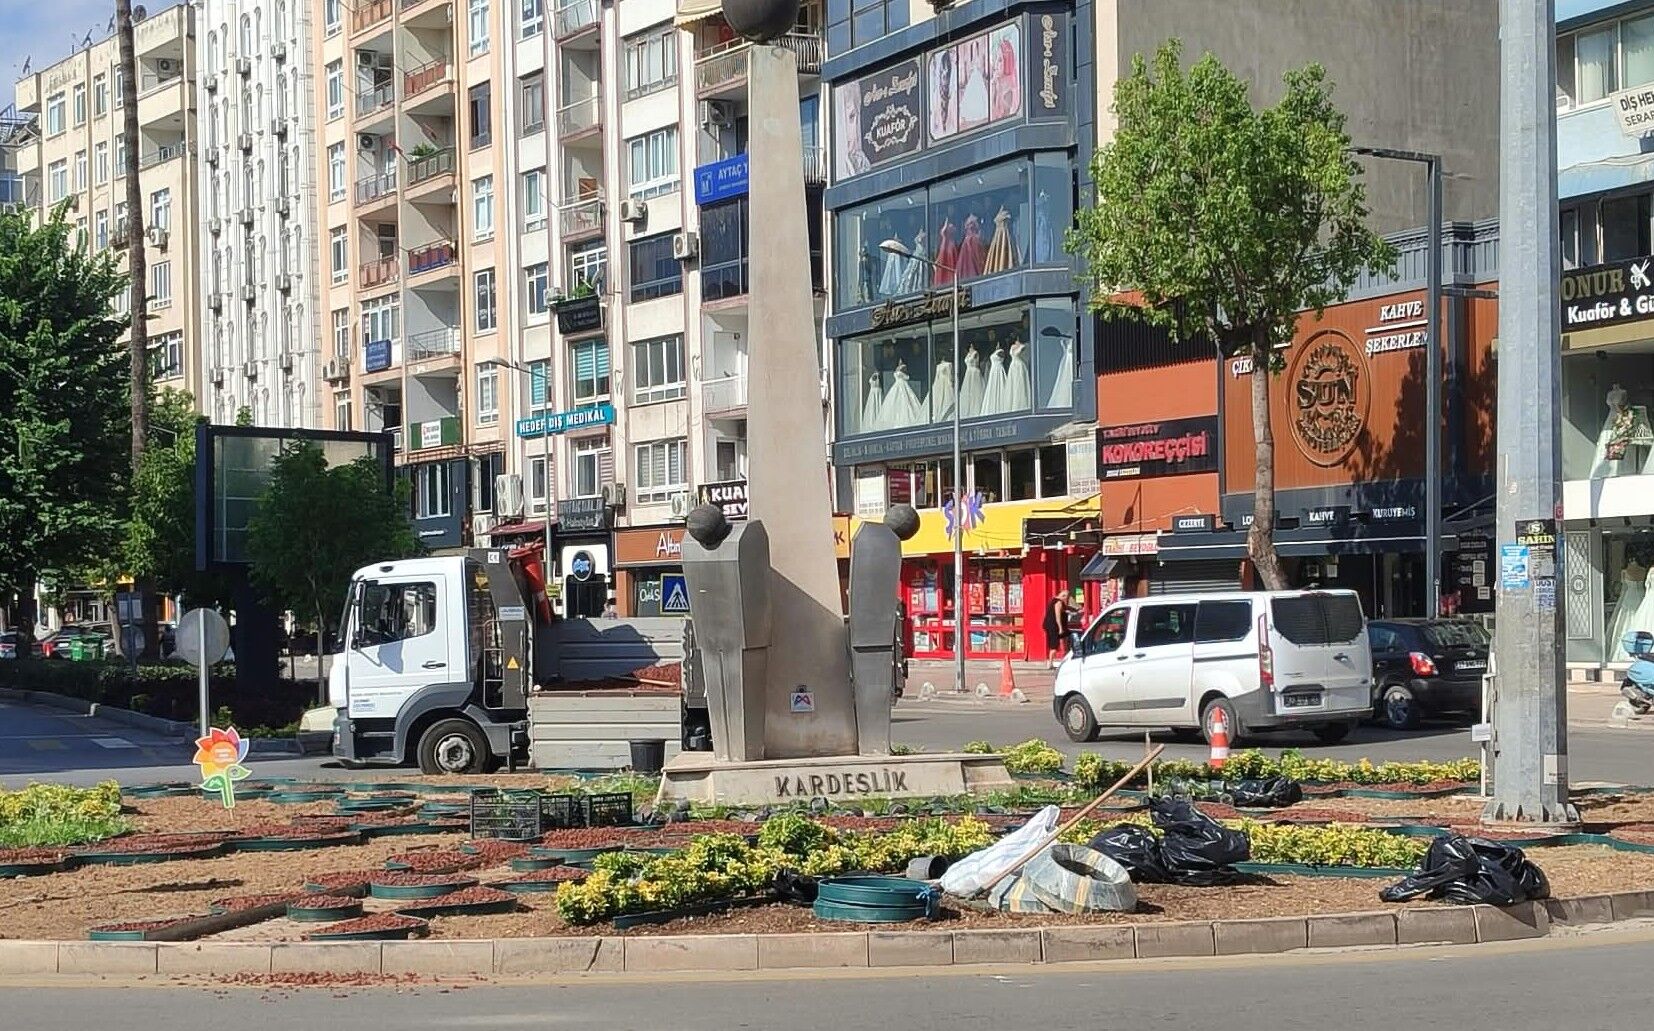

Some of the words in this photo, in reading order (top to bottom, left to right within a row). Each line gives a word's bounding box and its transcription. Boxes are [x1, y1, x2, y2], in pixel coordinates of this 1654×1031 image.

[1561, 269, 1625, 301] ONUR
[1380, 300, 1423, 321] KAHVE
[1567, 301, 1617, 324] Kuaför
[1619, 297, 1632, 316] &
[1297, 366, 1358, 410] SUN
[1309, 510, 1335, 522] KAHVE
[775, 768, 908, 798] KARDEŞLİK
